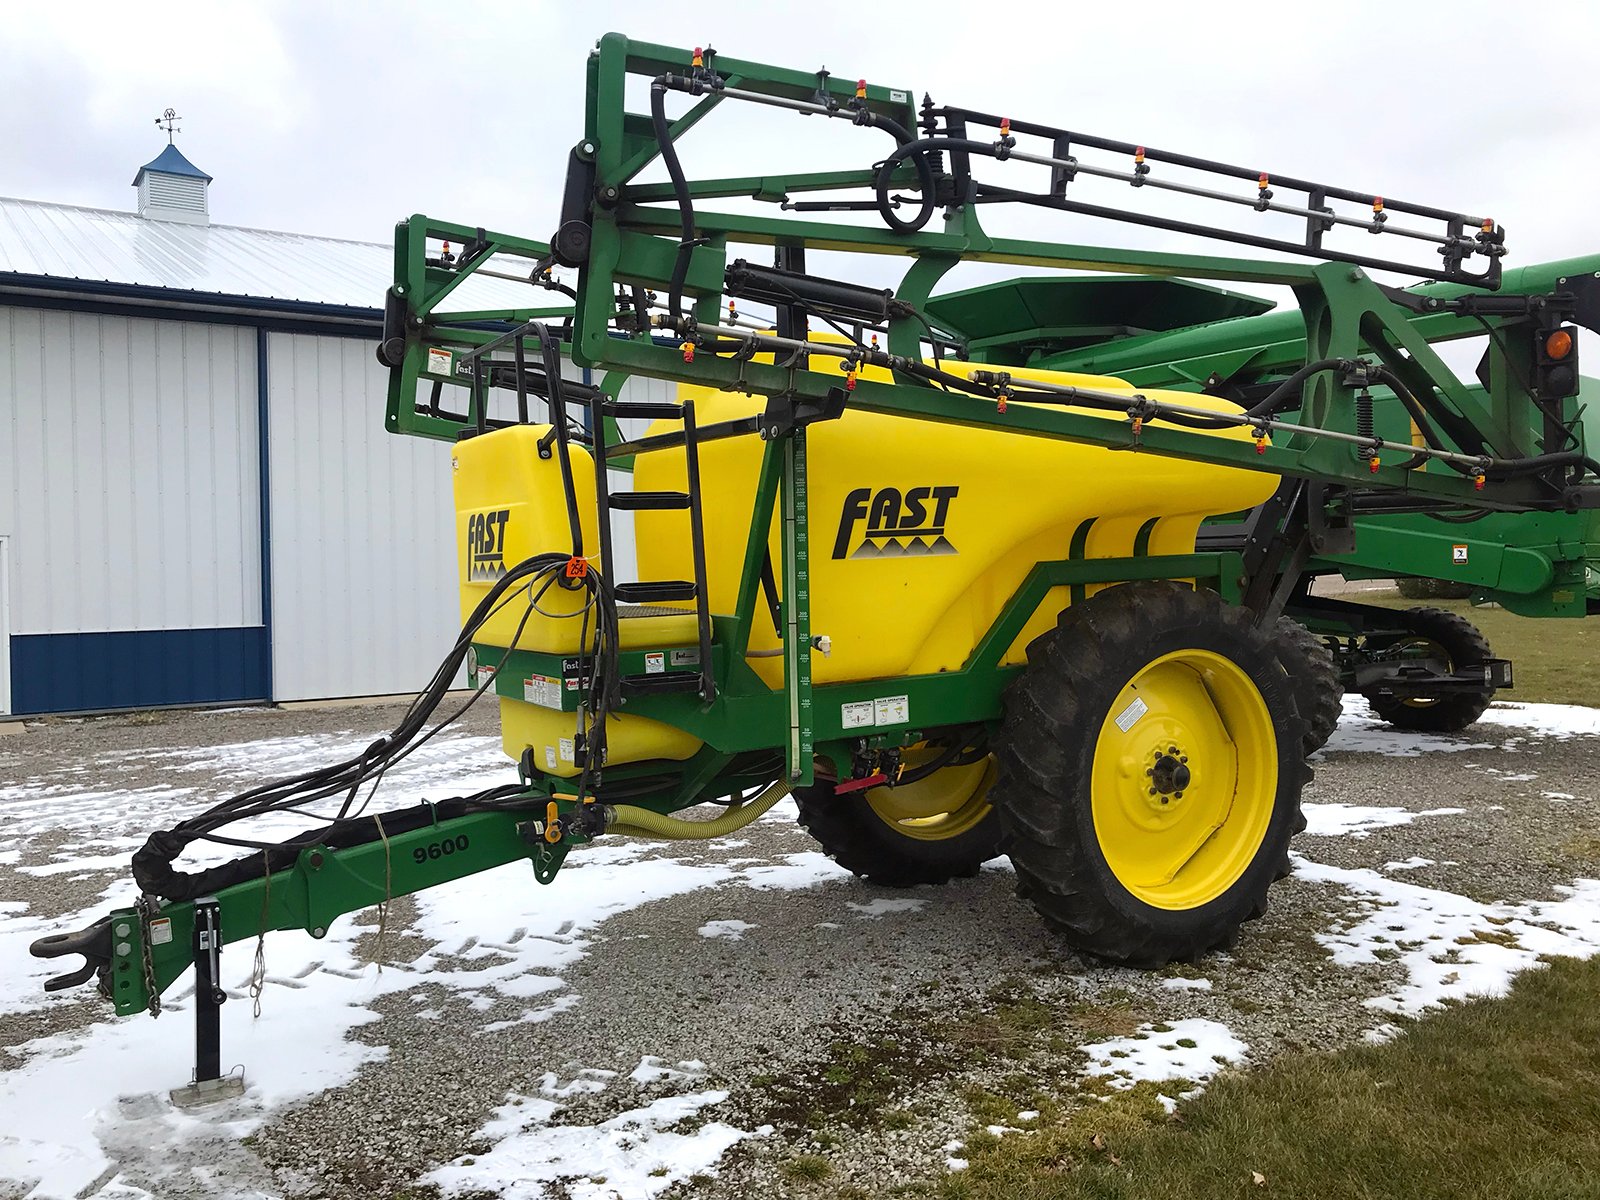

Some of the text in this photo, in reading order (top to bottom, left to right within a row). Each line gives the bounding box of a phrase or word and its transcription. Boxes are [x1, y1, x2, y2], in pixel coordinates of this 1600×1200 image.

[468, 510, 510, 582] FAST
[831, 486, 959, 560] FAST
[570, 563, 584, 575] 254
[413, 834, 470, 864] 9600
